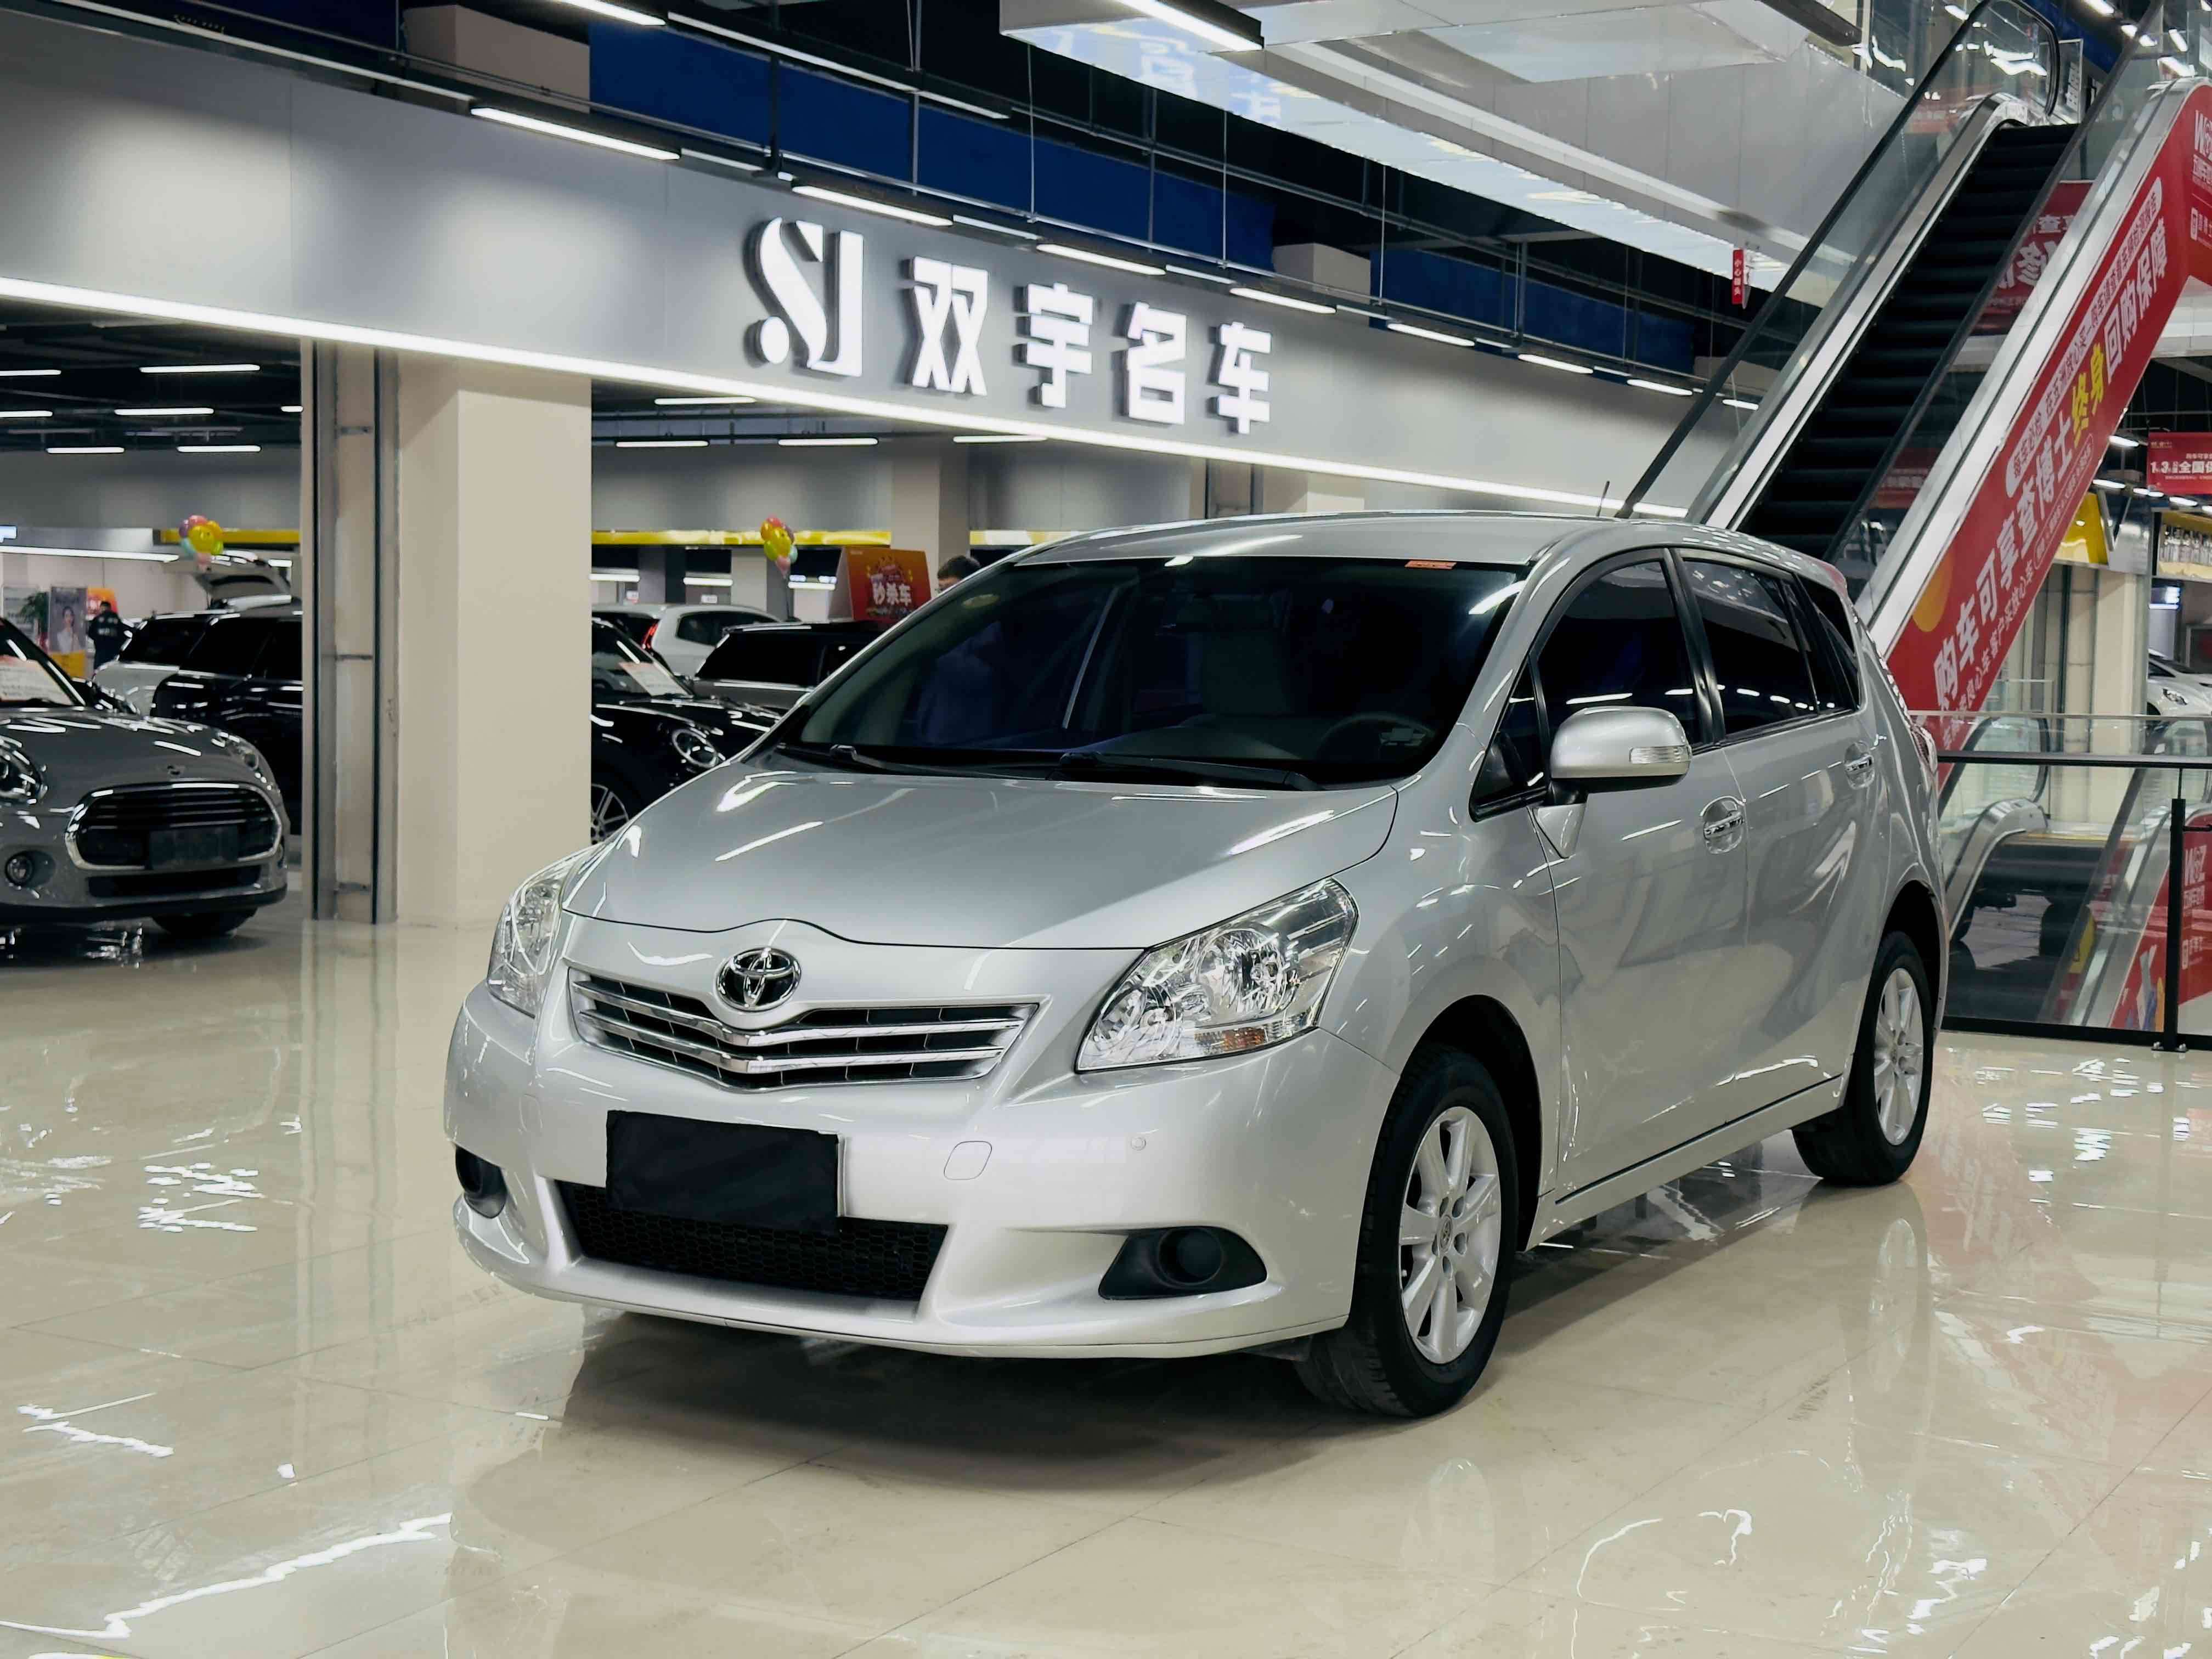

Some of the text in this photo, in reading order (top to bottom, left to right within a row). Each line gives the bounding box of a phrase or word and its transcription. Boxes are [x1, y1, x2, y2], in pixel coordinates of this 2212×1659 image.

[911, 256, 1271, 435] 双宇名车
[1933, 217, 2167, 722] 购车可享查博士终身回购保障
[873, 582, 912, 606] 秒杀车
